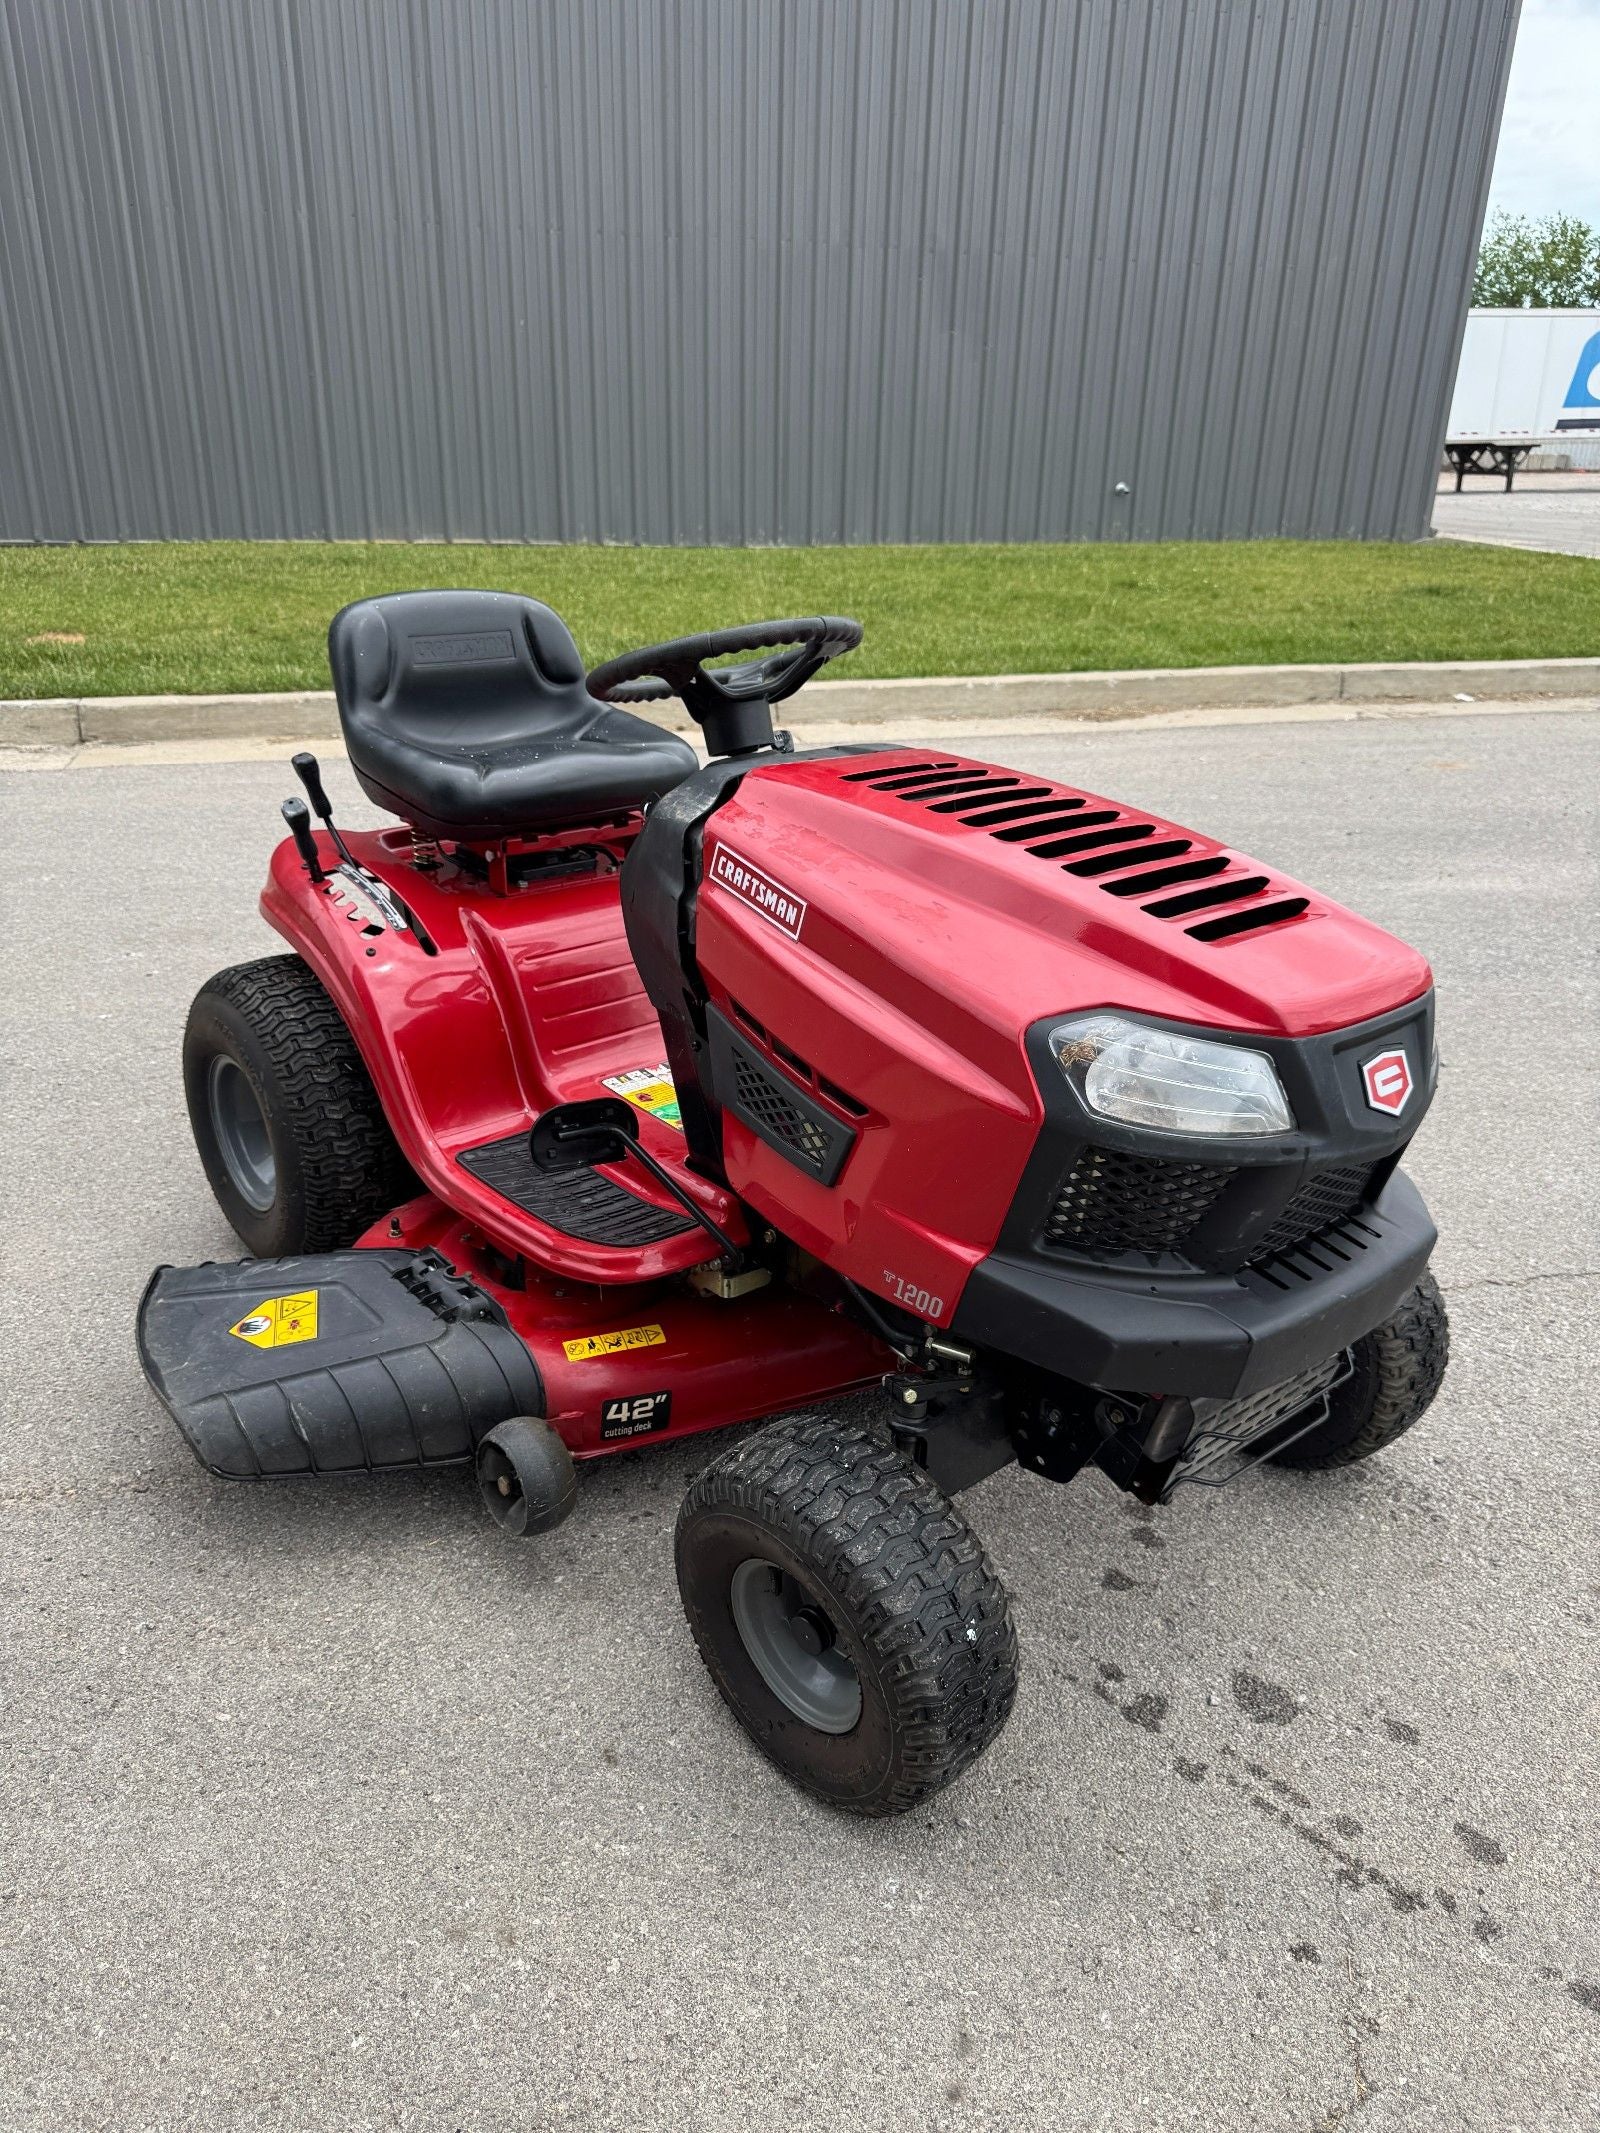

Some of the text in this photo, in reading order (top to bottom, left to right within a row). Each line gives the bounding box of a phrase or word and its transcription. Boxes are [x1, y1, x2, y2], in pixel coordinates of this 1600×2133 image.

[717, 855, 798, 925] CRAFTSMAN
[606, 1394, 667, 1422] 42"
[604, 1420, 652, 1438] cutting deck
